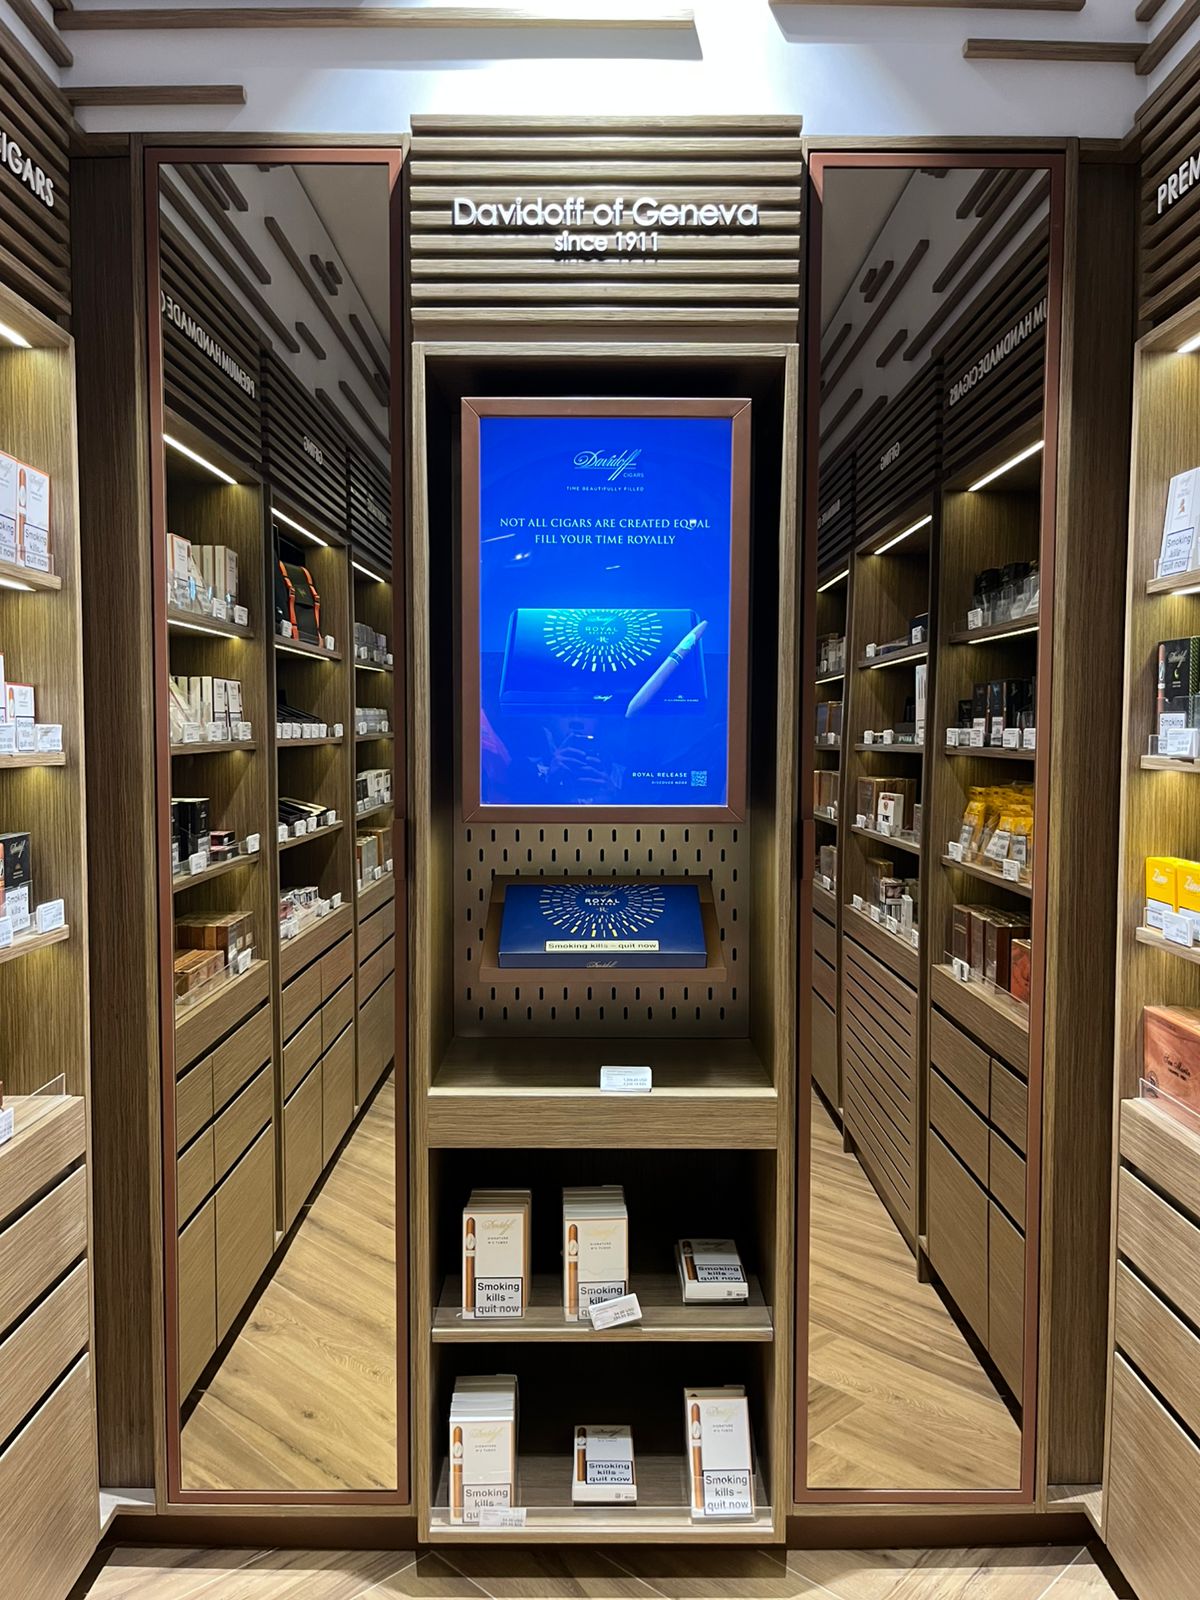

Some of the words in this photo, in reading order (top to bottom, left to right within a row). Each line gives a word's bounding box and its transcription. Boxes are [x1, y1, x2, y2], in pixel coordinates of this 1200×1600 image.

[0, 131, 54, 207] IGARS
[453, 197, 585, 226] Davidoff
[592, 197, 624, 226] of
[633, 197, 758, 226] Geneva
[554, 230, 608, 251] since
[615, 231, 659, 251] 1911
[574, 449, 642, 481] Davidoff
[500, 518, 525, 528] NOT
[528, 518, 548, 528] ALL
[550, 518, 592, 528] CIGARS
[595, 518, 616, 528] ARE
[619, 519, 670, 529] CREATED
[535, 534, 557, 544] FILL
[560, 535, 592, 544] YOUR
[595, 535, 623, 544] TIME
[627, 535, 676, 544] ROYALLY
[1167, 535, 1191, 548] Smoking
[1160, 717, 1184, 727] Smoking
[477, 1282, 520, 1292] Smoking
[580, 1286, 623, 1295] Smoking
[478, 1305, 497, 1314] quit
[706, 1475, 747, 1486] Smoking
[465, 1489, 508, 1498] Smoking
[715, 1488, 734, 1496] kills
[474, 1499, 494, 1507] kills
[707, 1500, 726, 1511] quit
[729, 1501, 749, 1509] now
[466, 1511, 480, 1519] qu
